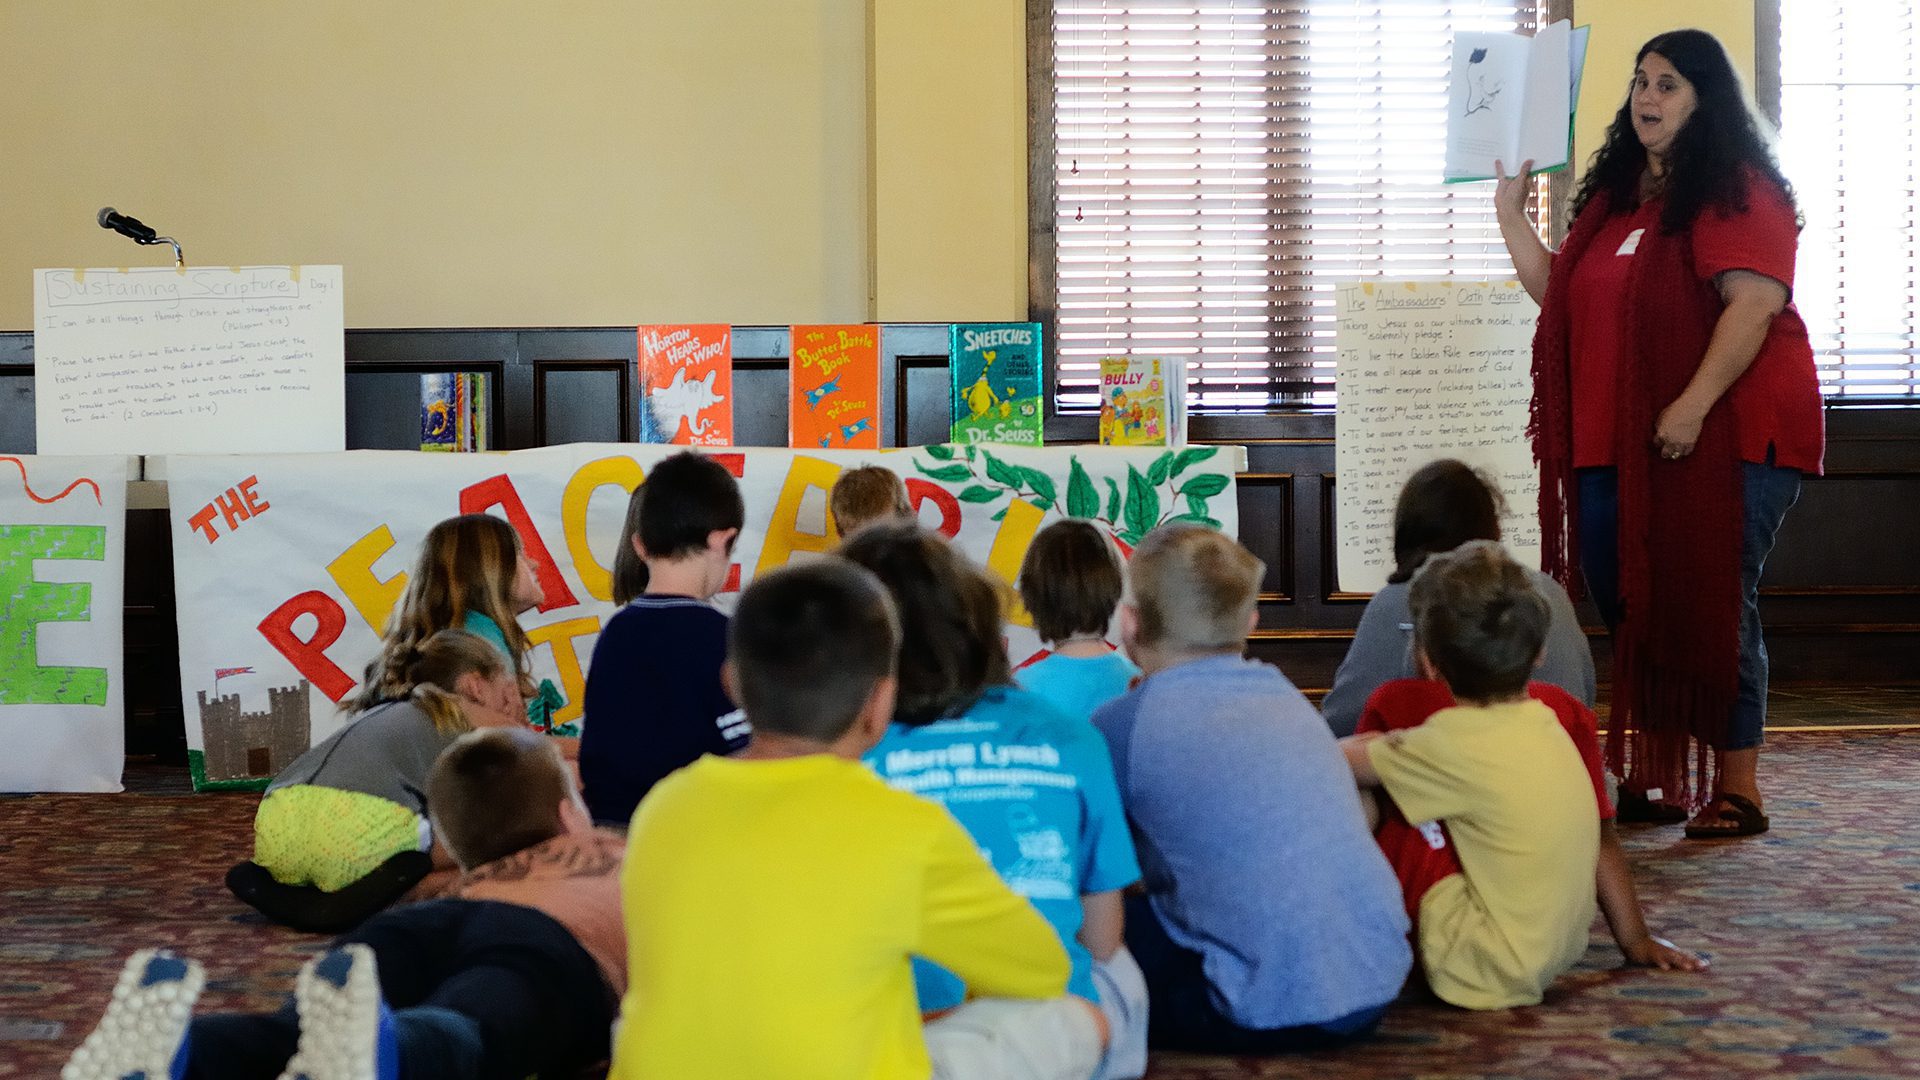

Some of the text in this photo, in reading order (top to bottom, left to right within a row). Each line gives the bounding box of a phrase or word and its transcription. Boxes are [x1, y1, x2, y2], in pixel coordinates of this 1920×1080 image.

[52, 272, 290, 309] Sustaining Scripture
[311, 278, 328, 295] Day
[1339, 287, 1365, 311] The
[1457, 288, 1483, 304] Oath
[1489, 286, 1527, 305] Against
[1337, 318, 1368, 336] Taking
[1379, 317, 1407, 330] Jesus
[1414, 321, 1425, 329] as
[1431, 320, 1445, 328] our
[1450, 314, 1483, 327] ultimate
[1519, 317, 1532, 326] we
[806, 332, 825, 342] The
[964, 329, 1033, 351] SNEETCHES
[1368, 330, 1410, 345] solemnly
[666, 337, 701, 366] HEARS
[693, 333, 728, 366] WHO!
[796, 330, 874, 368] Butter Battle
[1344, 348, 1360, 362] To
[1386, 350, 1404, 360] the
[1411, 347, 1440, 360] Golden
[1443, 345, 1461, 358] Rule
[1469, 346, 1515, 362] everywhere
[817, 351, 850, 376] Book
[1346, 368, 1359, 379] To
[1384, 366, 1396, 377] all
[1400, 365, 1422, 380] people
[1444, 363, 1475, 375] children
[1479, 359, 1490, 373] of
[1494, 361, 1514, 372] God
[1104, 372, 1144, 385] BULLY
[1346, 384, 1360, 396] To
[1395, 386, 1433, 400] everyone
[1438, 380, 1474, 396] (including
[1510, 378, 1525, 389] with
[842, 400, 868, 413] Seuss
[1347, 403, 1361, 415] To
[1364, 406, 1388, 414] never
[1394, 404, 1408, 417] pay
[1414, 399, 1432, 411] back
[1438, 399, 1468, 410] violence
[1472, 399, 1491, 409] with
[1439, 410, 1473, 419] situation
[1480, 409, 1504, 418] worse
[966, 422, 1037, 446] Dr. Seuss
[1366, 428, 1376, 438] be
[1379, 430, 1403, 438] aware
[1438, 422, 1470, 438] feelings
[1474, 424, 1487, 434] but
[1491, 420, 1514, 432] control
[1364, 444, 1386, 454] stand
[1392, 444, 1409, 452] with
[1458, 438, 1474, 448] have
[1478, 438, 1497, 447] been
[1501, 434, 1519, 445] hurt
[1372, 457, 1387, 467] any
[1392, 455, 1408, 466] way
[1364, 481, 1380, 490] tell
[1503, 472, 1534, 481] trouble
[187, 474, 270, 543] THE
[1366, 536, 1382, 547] help
[1512, 533, 1538, 546] Peace
[1364, 547, 1382, 556] work
[1363, 557, 1385, 568] every
[885, 743, 976, 775] Merrill
[979, 740, 1060, 768] Lynch
